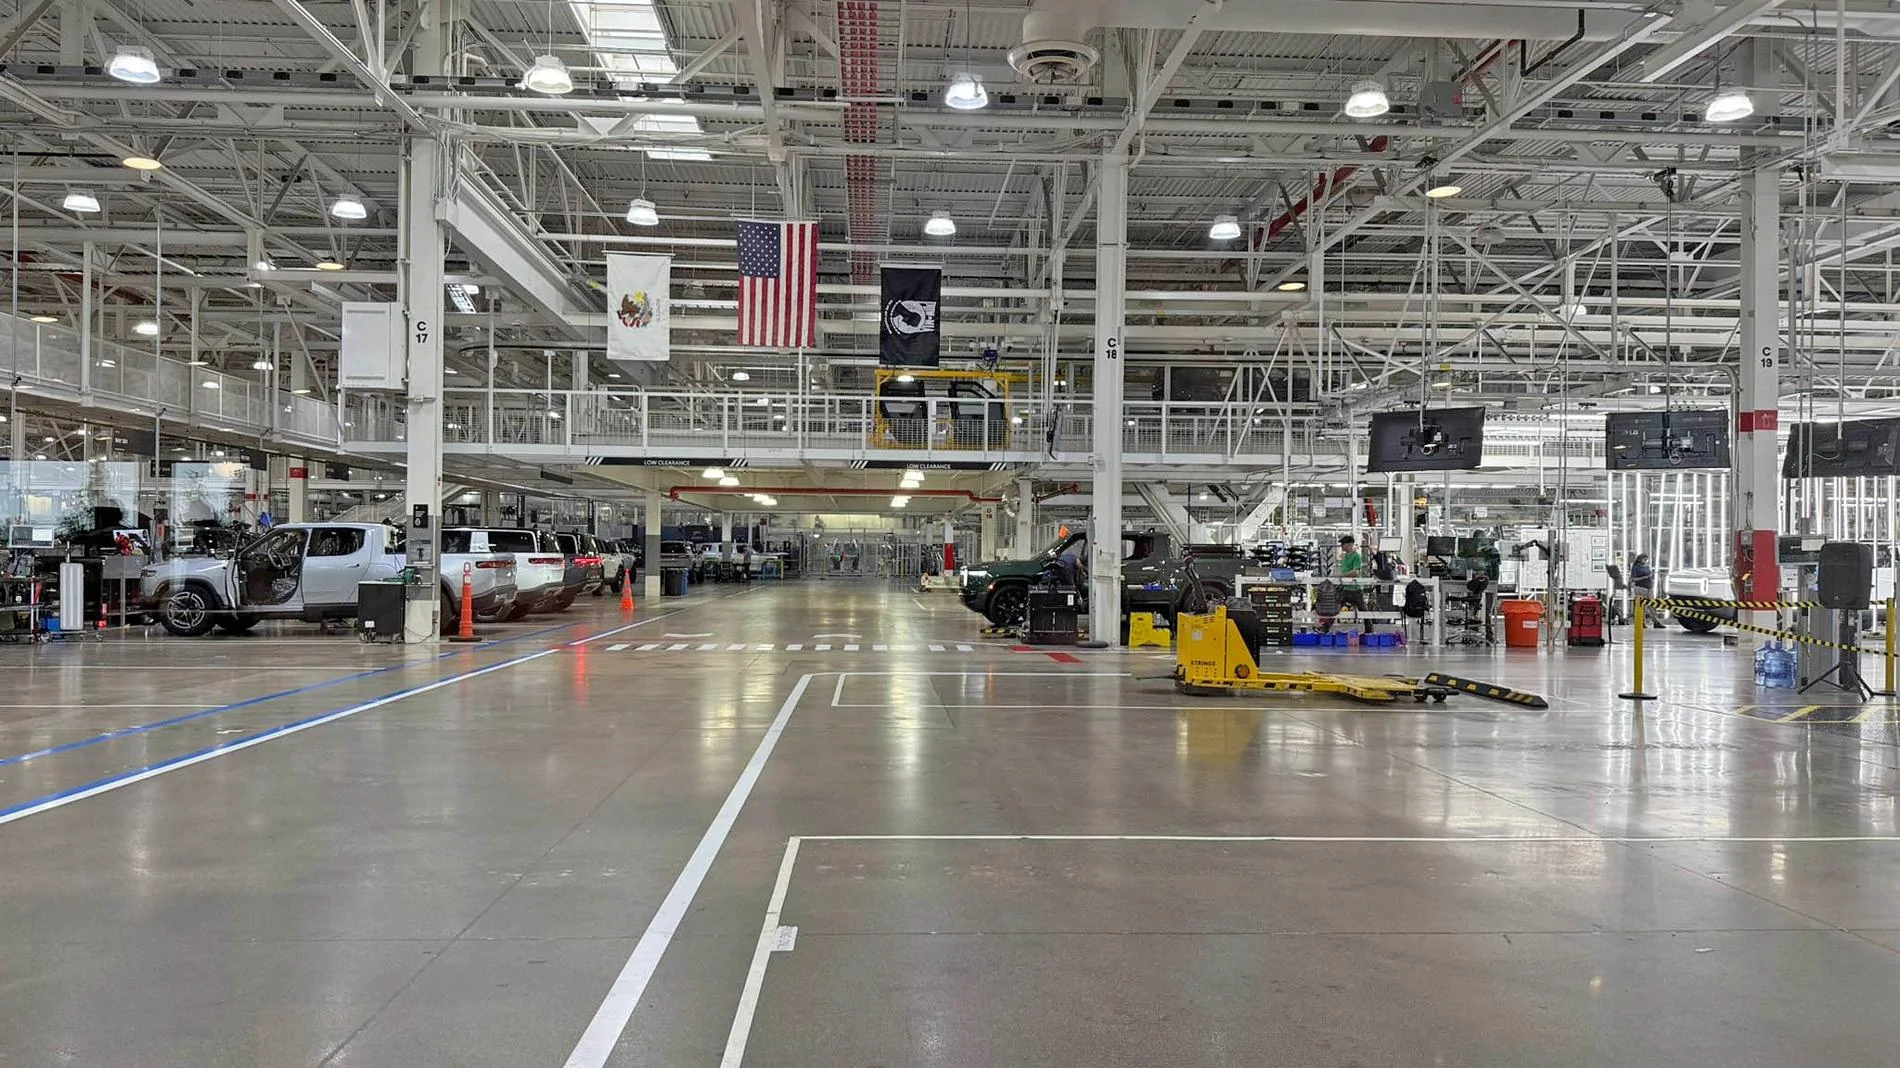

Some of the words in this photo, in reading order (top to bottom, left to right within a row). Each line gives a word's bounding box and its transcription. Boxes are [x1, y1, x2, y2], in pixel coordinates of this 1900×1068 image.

[417, 321, 426, 331] C
[416, 333, 428, 343] 17
[1107, 338, 1116, 347] C
[1106, 349, 1117, 359] 18
[1762, 347, 1771, 356] C
[1761, 358, 1772, 368] 19
